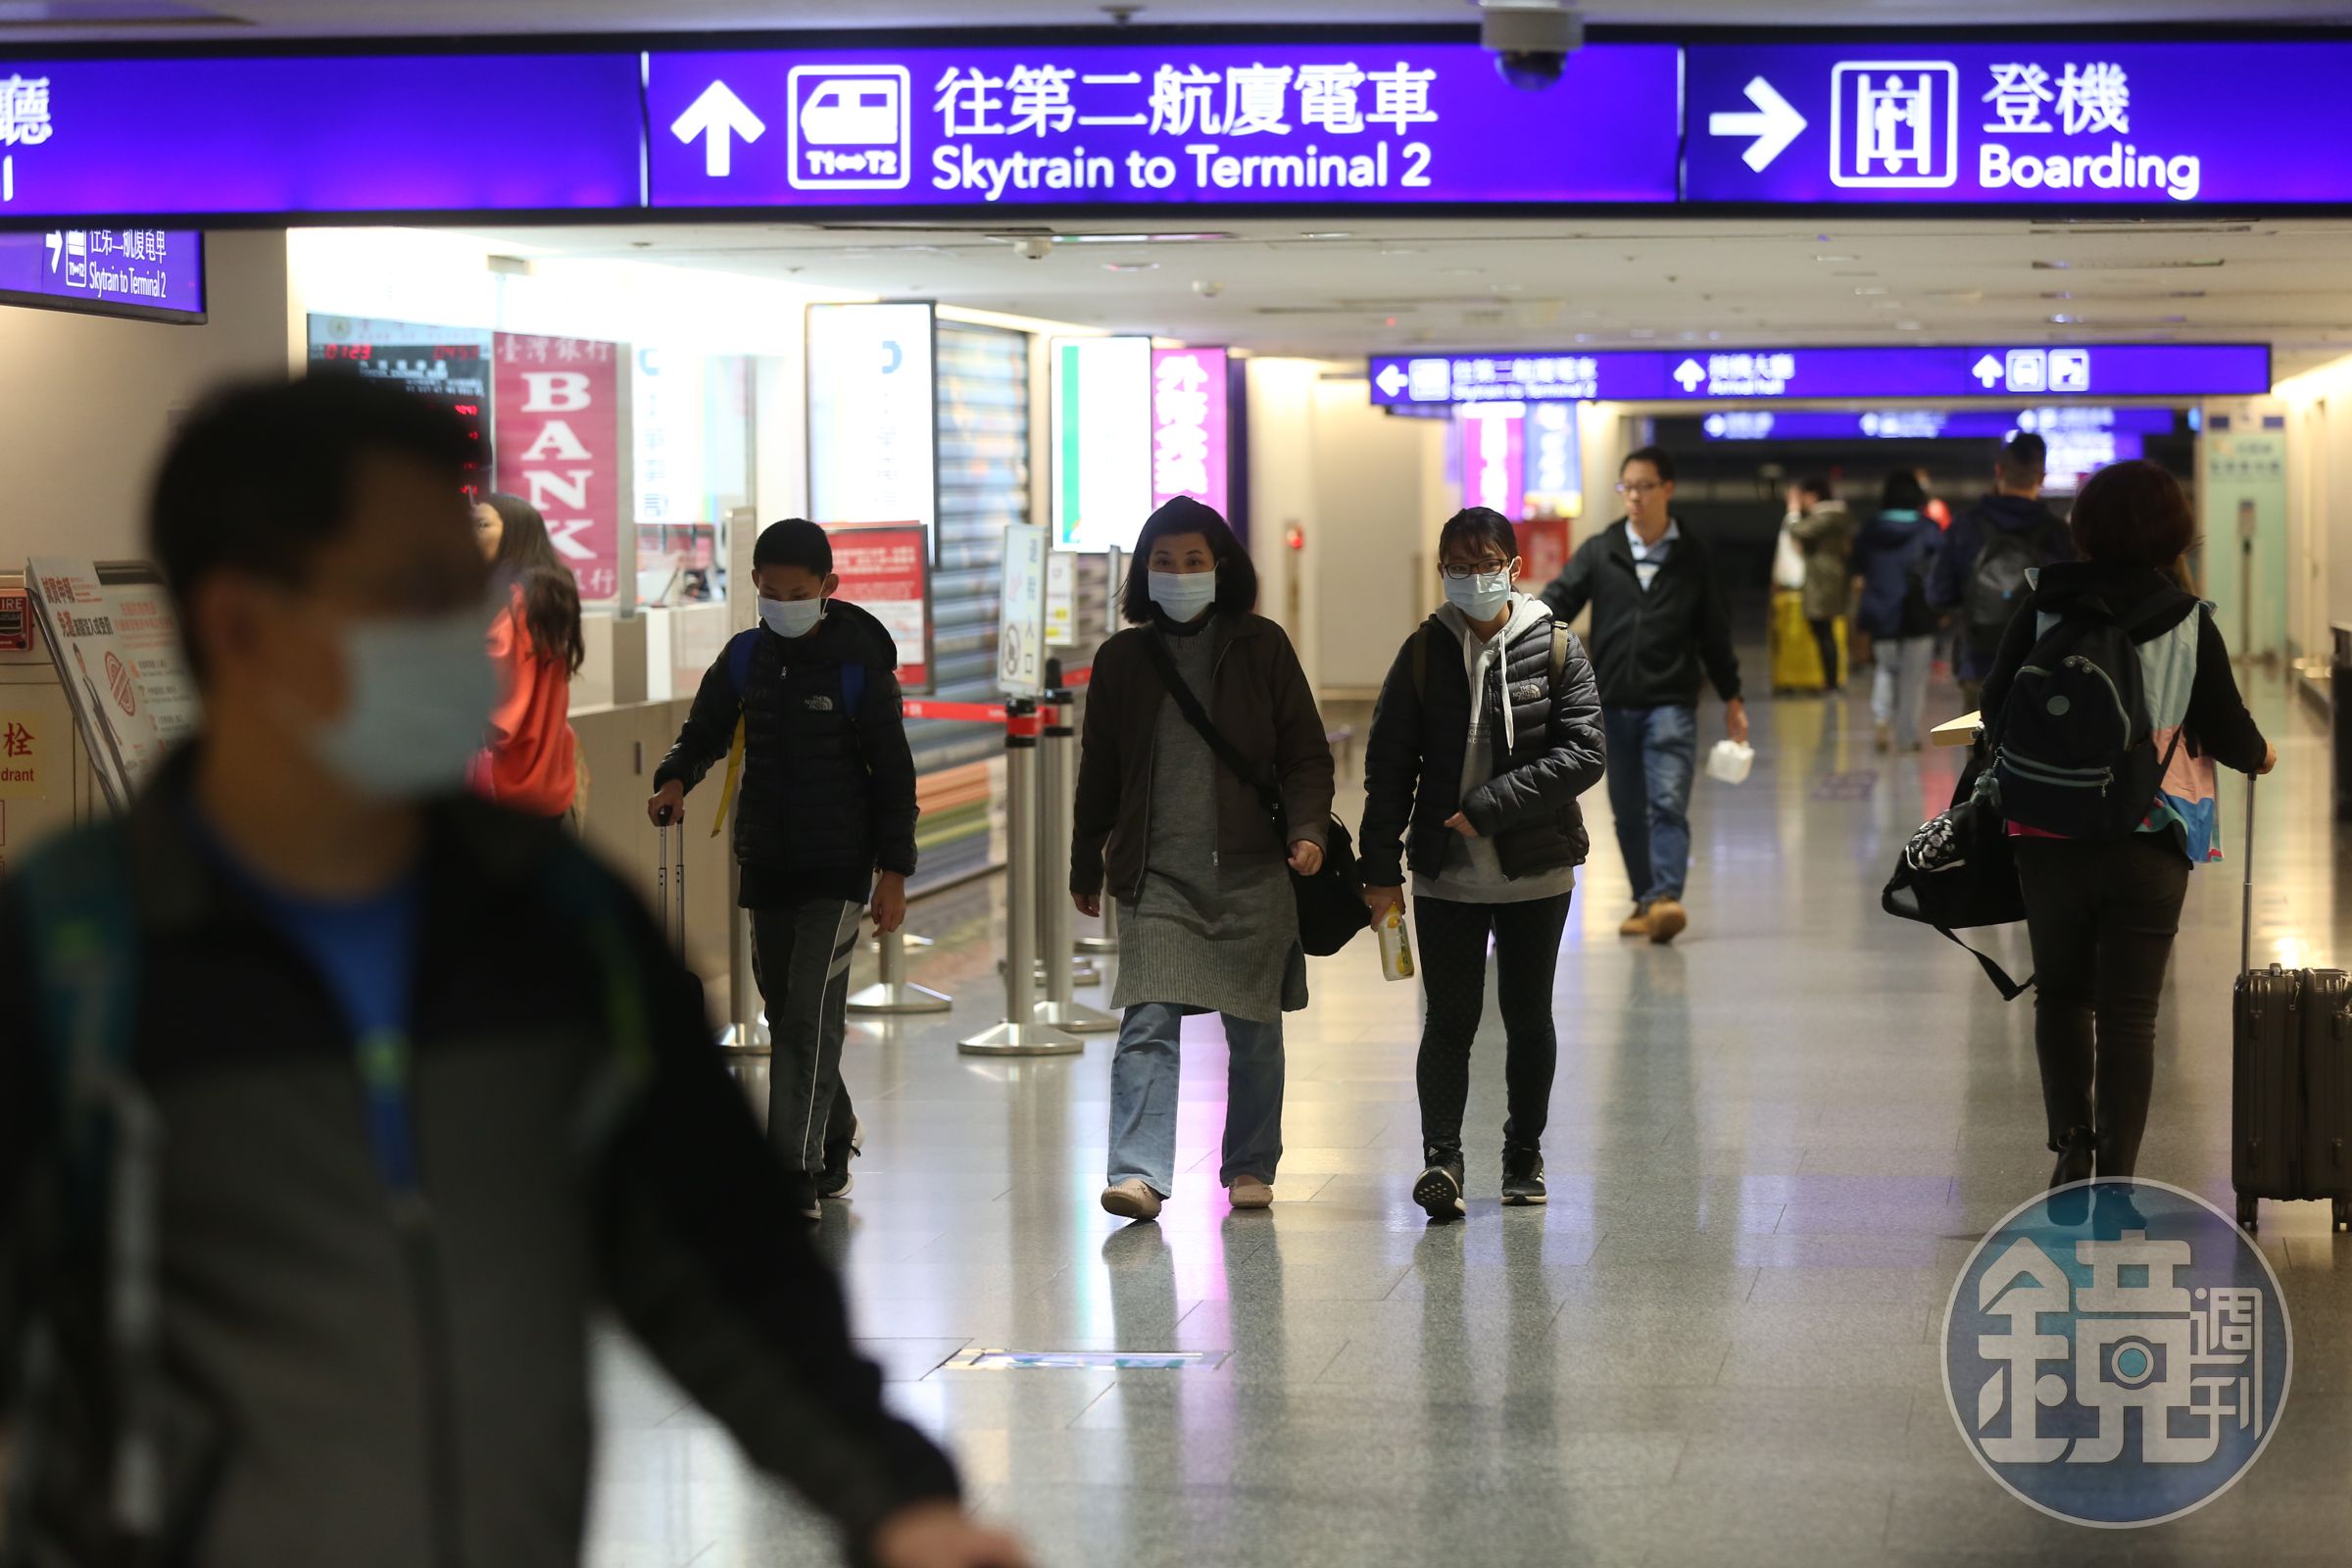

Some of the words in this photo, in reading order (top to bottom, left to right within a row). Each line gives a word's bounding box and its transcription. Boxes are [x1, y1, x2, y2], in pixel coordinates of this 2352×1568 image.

[933, 62, 1438, 137] 往第二航廈電車
[1982, 62, 2130, 136] 登機
[932, 144, 1114, 202] Skytrain
[1126, 147, 1177, 188] to
[1185, 143, 1389, 188] Terminal
[1401, 145, 1432, 188] 2
[1979, 140, 2200, 201] Boarding
[89, 261, 120, 298] Skytrain
[120, 270, 128, 293] to
[128, 267, 161, 298] Terminal
[161, 271, 167, 298] 2
[520, 371, 599, 561] BANK
[3, 721, 35, 759] 栓
